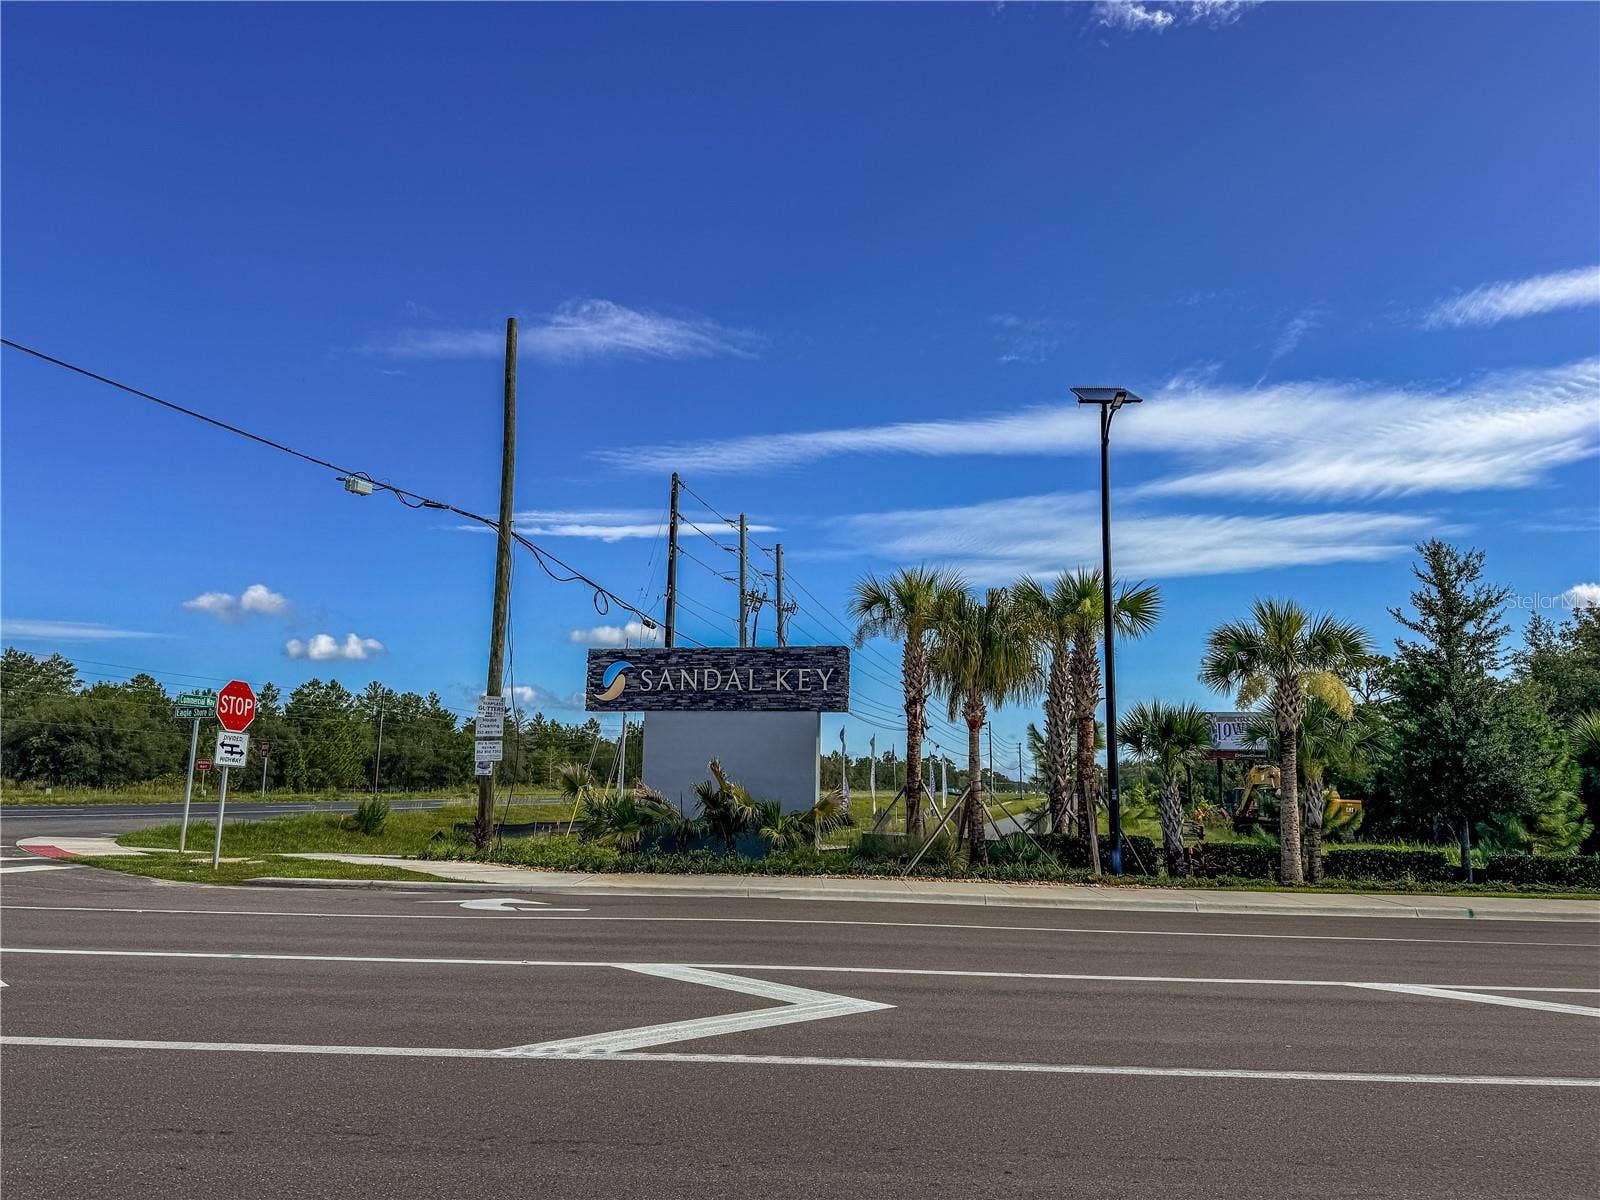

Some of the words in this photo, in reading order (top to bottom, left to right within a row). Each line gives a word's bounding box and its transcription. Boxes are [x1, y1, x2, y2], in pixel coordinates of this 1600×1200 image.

[640, 668, 762, 691] SANDAL
[776, 668, 834, 691] KEY
[220, 694, 253, 717] STOP
[176, 708, 192, 718] Eagle
[193, 708, 207, 717] Shore
[223, 734, 244, 742] DIVIDED
[220, 756, 241, 764] HIGHWAY
